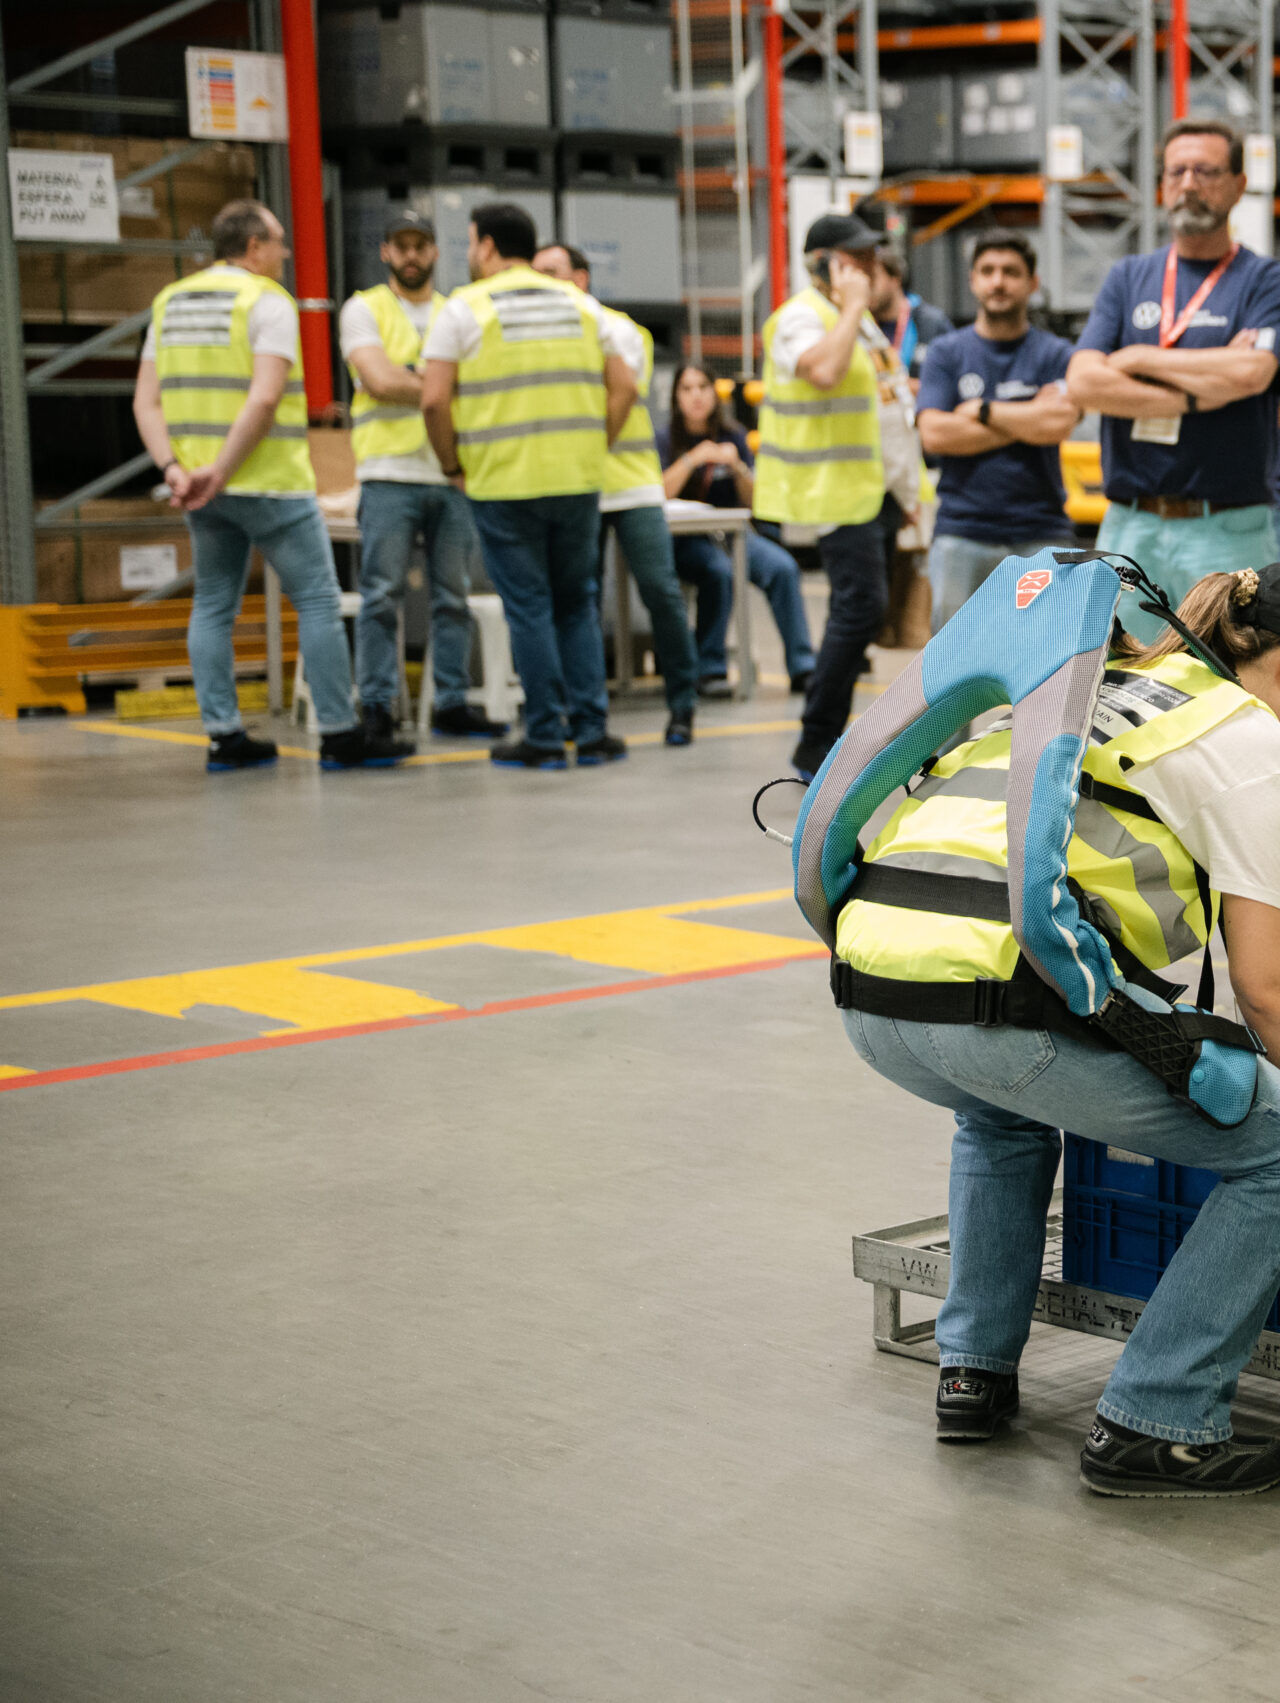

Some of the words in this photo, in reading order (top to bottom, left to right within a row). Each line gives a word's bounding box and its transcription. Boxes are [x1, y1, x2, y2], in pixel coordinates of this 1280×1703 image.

[17, 169, 83, 190] MATERIAL
[19, 207, 45, 224] PUT
[49, 208, 87, 224] AWAY
[901, 1257, 938, 1287] VW
